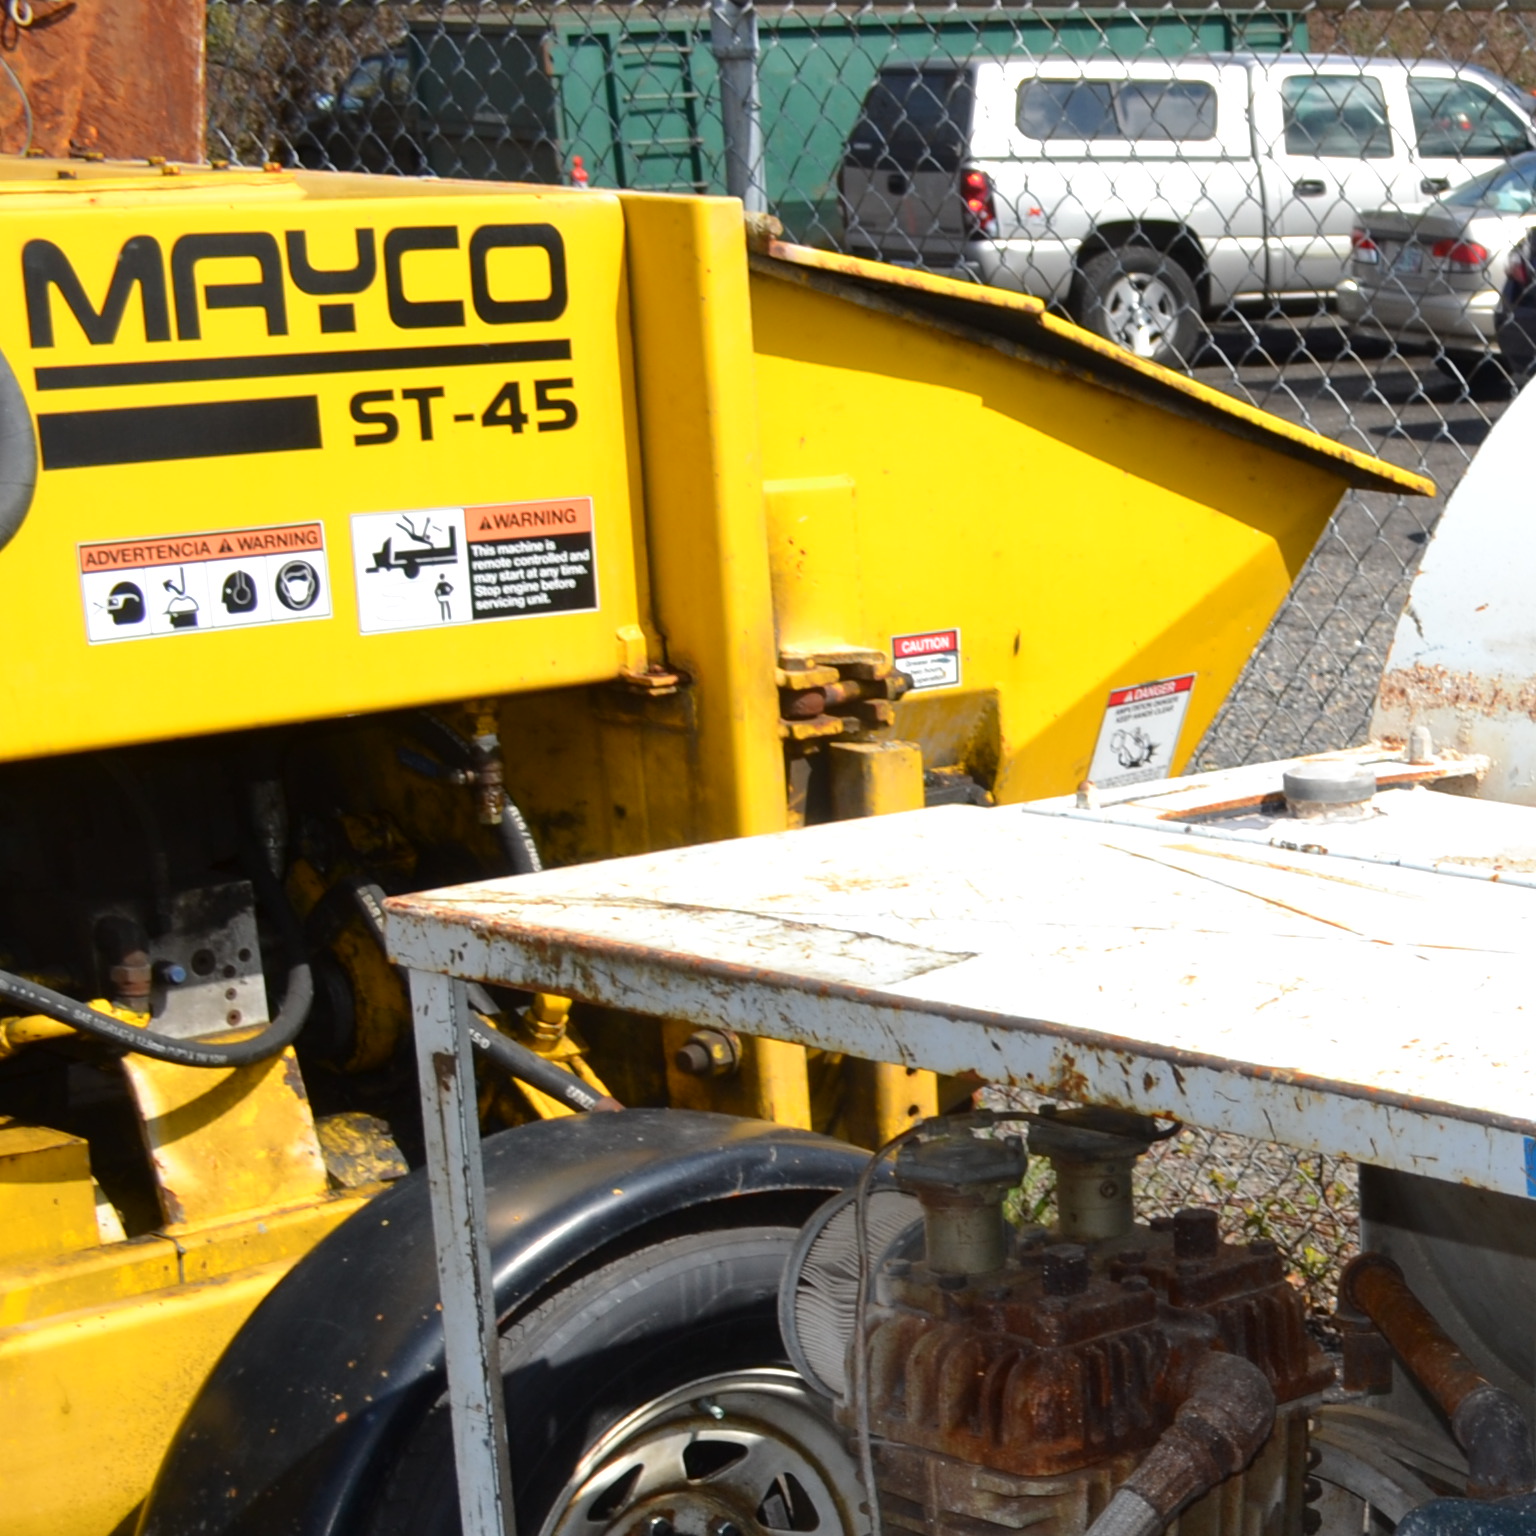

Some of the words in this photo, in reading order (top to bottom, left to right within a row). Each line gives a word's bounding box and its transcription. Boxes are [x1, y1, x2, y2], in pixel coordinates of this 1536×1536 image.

[22, 223, 568, 349] MAYCO
[349, 378, 578, 446] ST-45
[493, 508, 576, 529] WARNING
[85, 541, 212, 567] ADVERTENCIA
[237, 530, 318, 551] WARNING
[470, 544, 496, 557] This
[497, 541, 544, 555] machine
[545, 539, 556, 551] is
[472, 559, 512, 571] remote
[513, 551, 568, 567] controlled
[569, 549, 590, 562] and
[473, 573, 497, 585] may
[499, 569, 525, 582] start
[526, 568, 538, 579] at
[539, 567, 559, 580] any
[560, 564, 588, 576] time.
[474, 584, 501, 597] Stop
[502, 582, 539, 596] engine
[541, 578, 577, 591] before
[475, 596, 525, 610] servicing
[527, 593, 551, 606] unit.
[901, 636, 950, 654] CAUTION
[1134, 681, 1177, 700] DANGER
